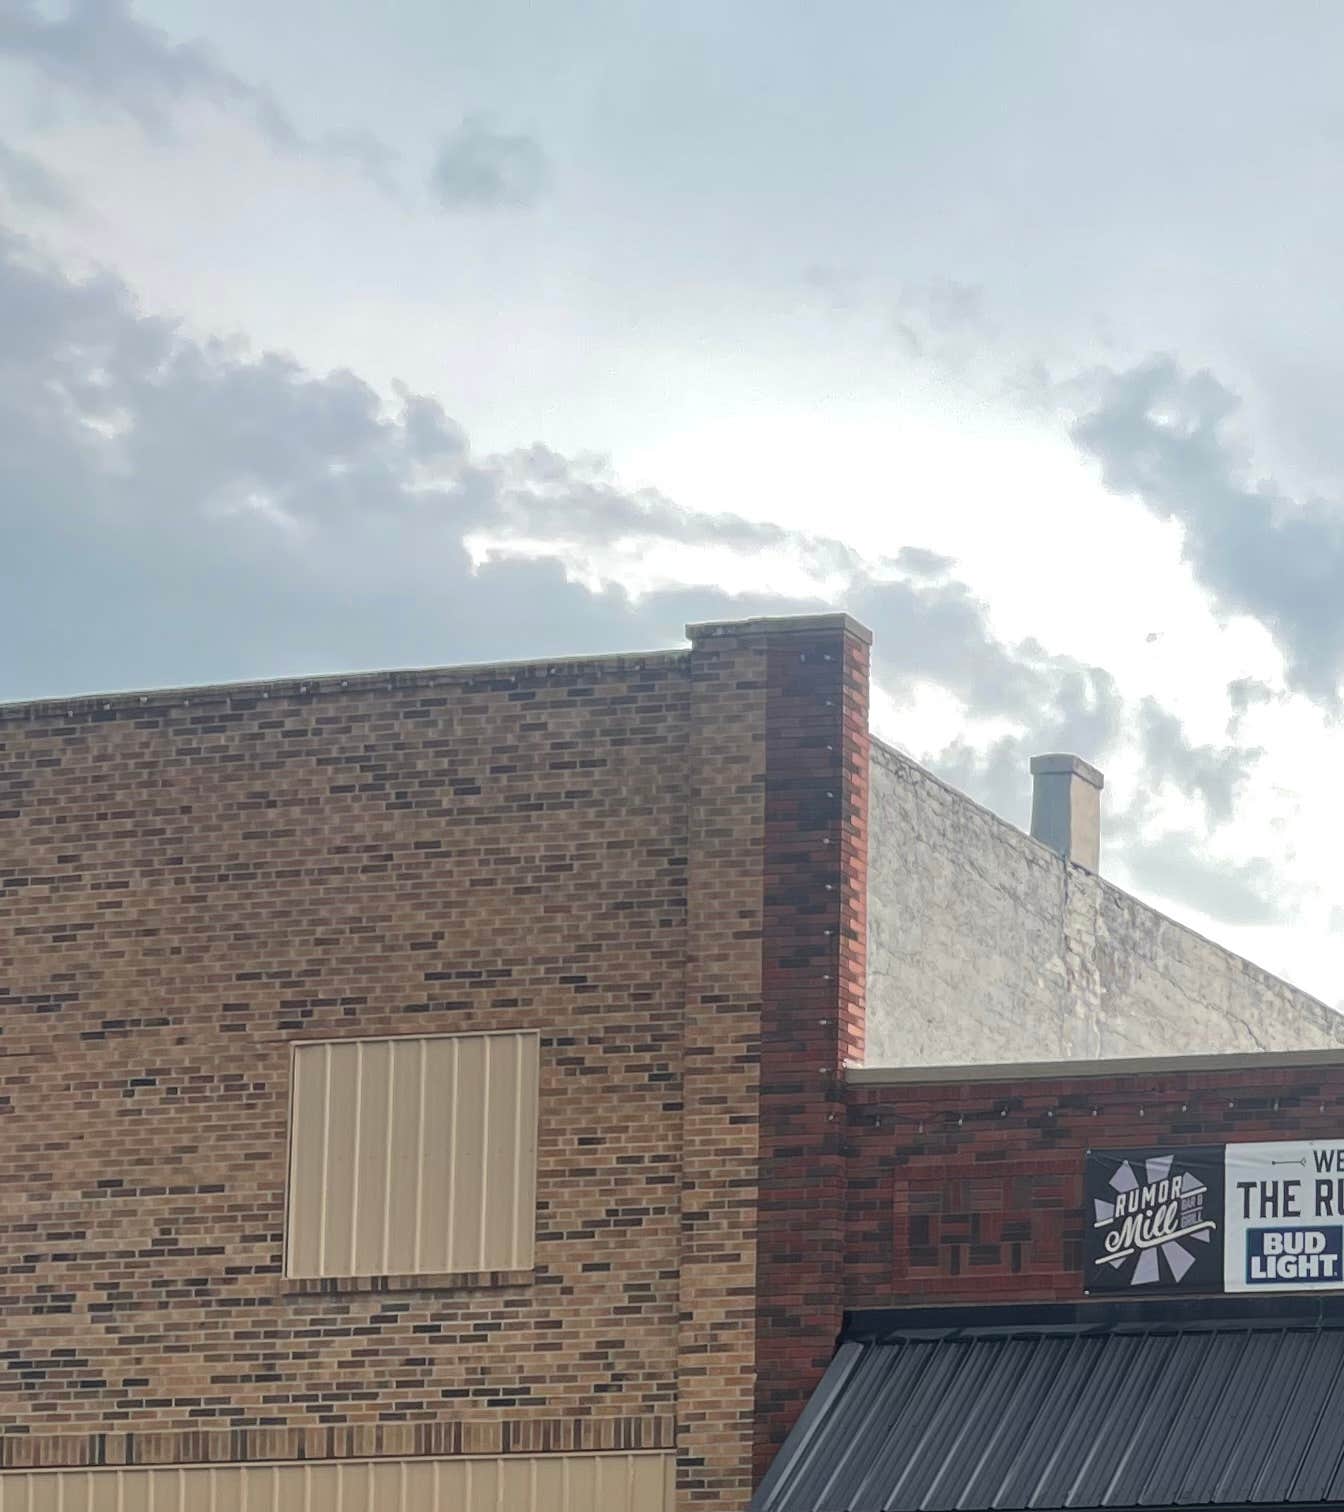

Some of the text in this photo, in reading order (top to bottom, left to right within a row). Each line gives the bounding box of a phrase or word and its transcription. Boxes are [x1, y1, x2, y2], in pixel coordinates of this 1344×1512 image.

[1115, 1175, 1182, 1218] RUMOR
[1236, 1179, 1302, 1219] THE
[1104, 1200, 1179, 1253] Mill
[1262, 1231, 1326, 1256] BUD
[1250, 1254, 1338, 1279] LIGHT
